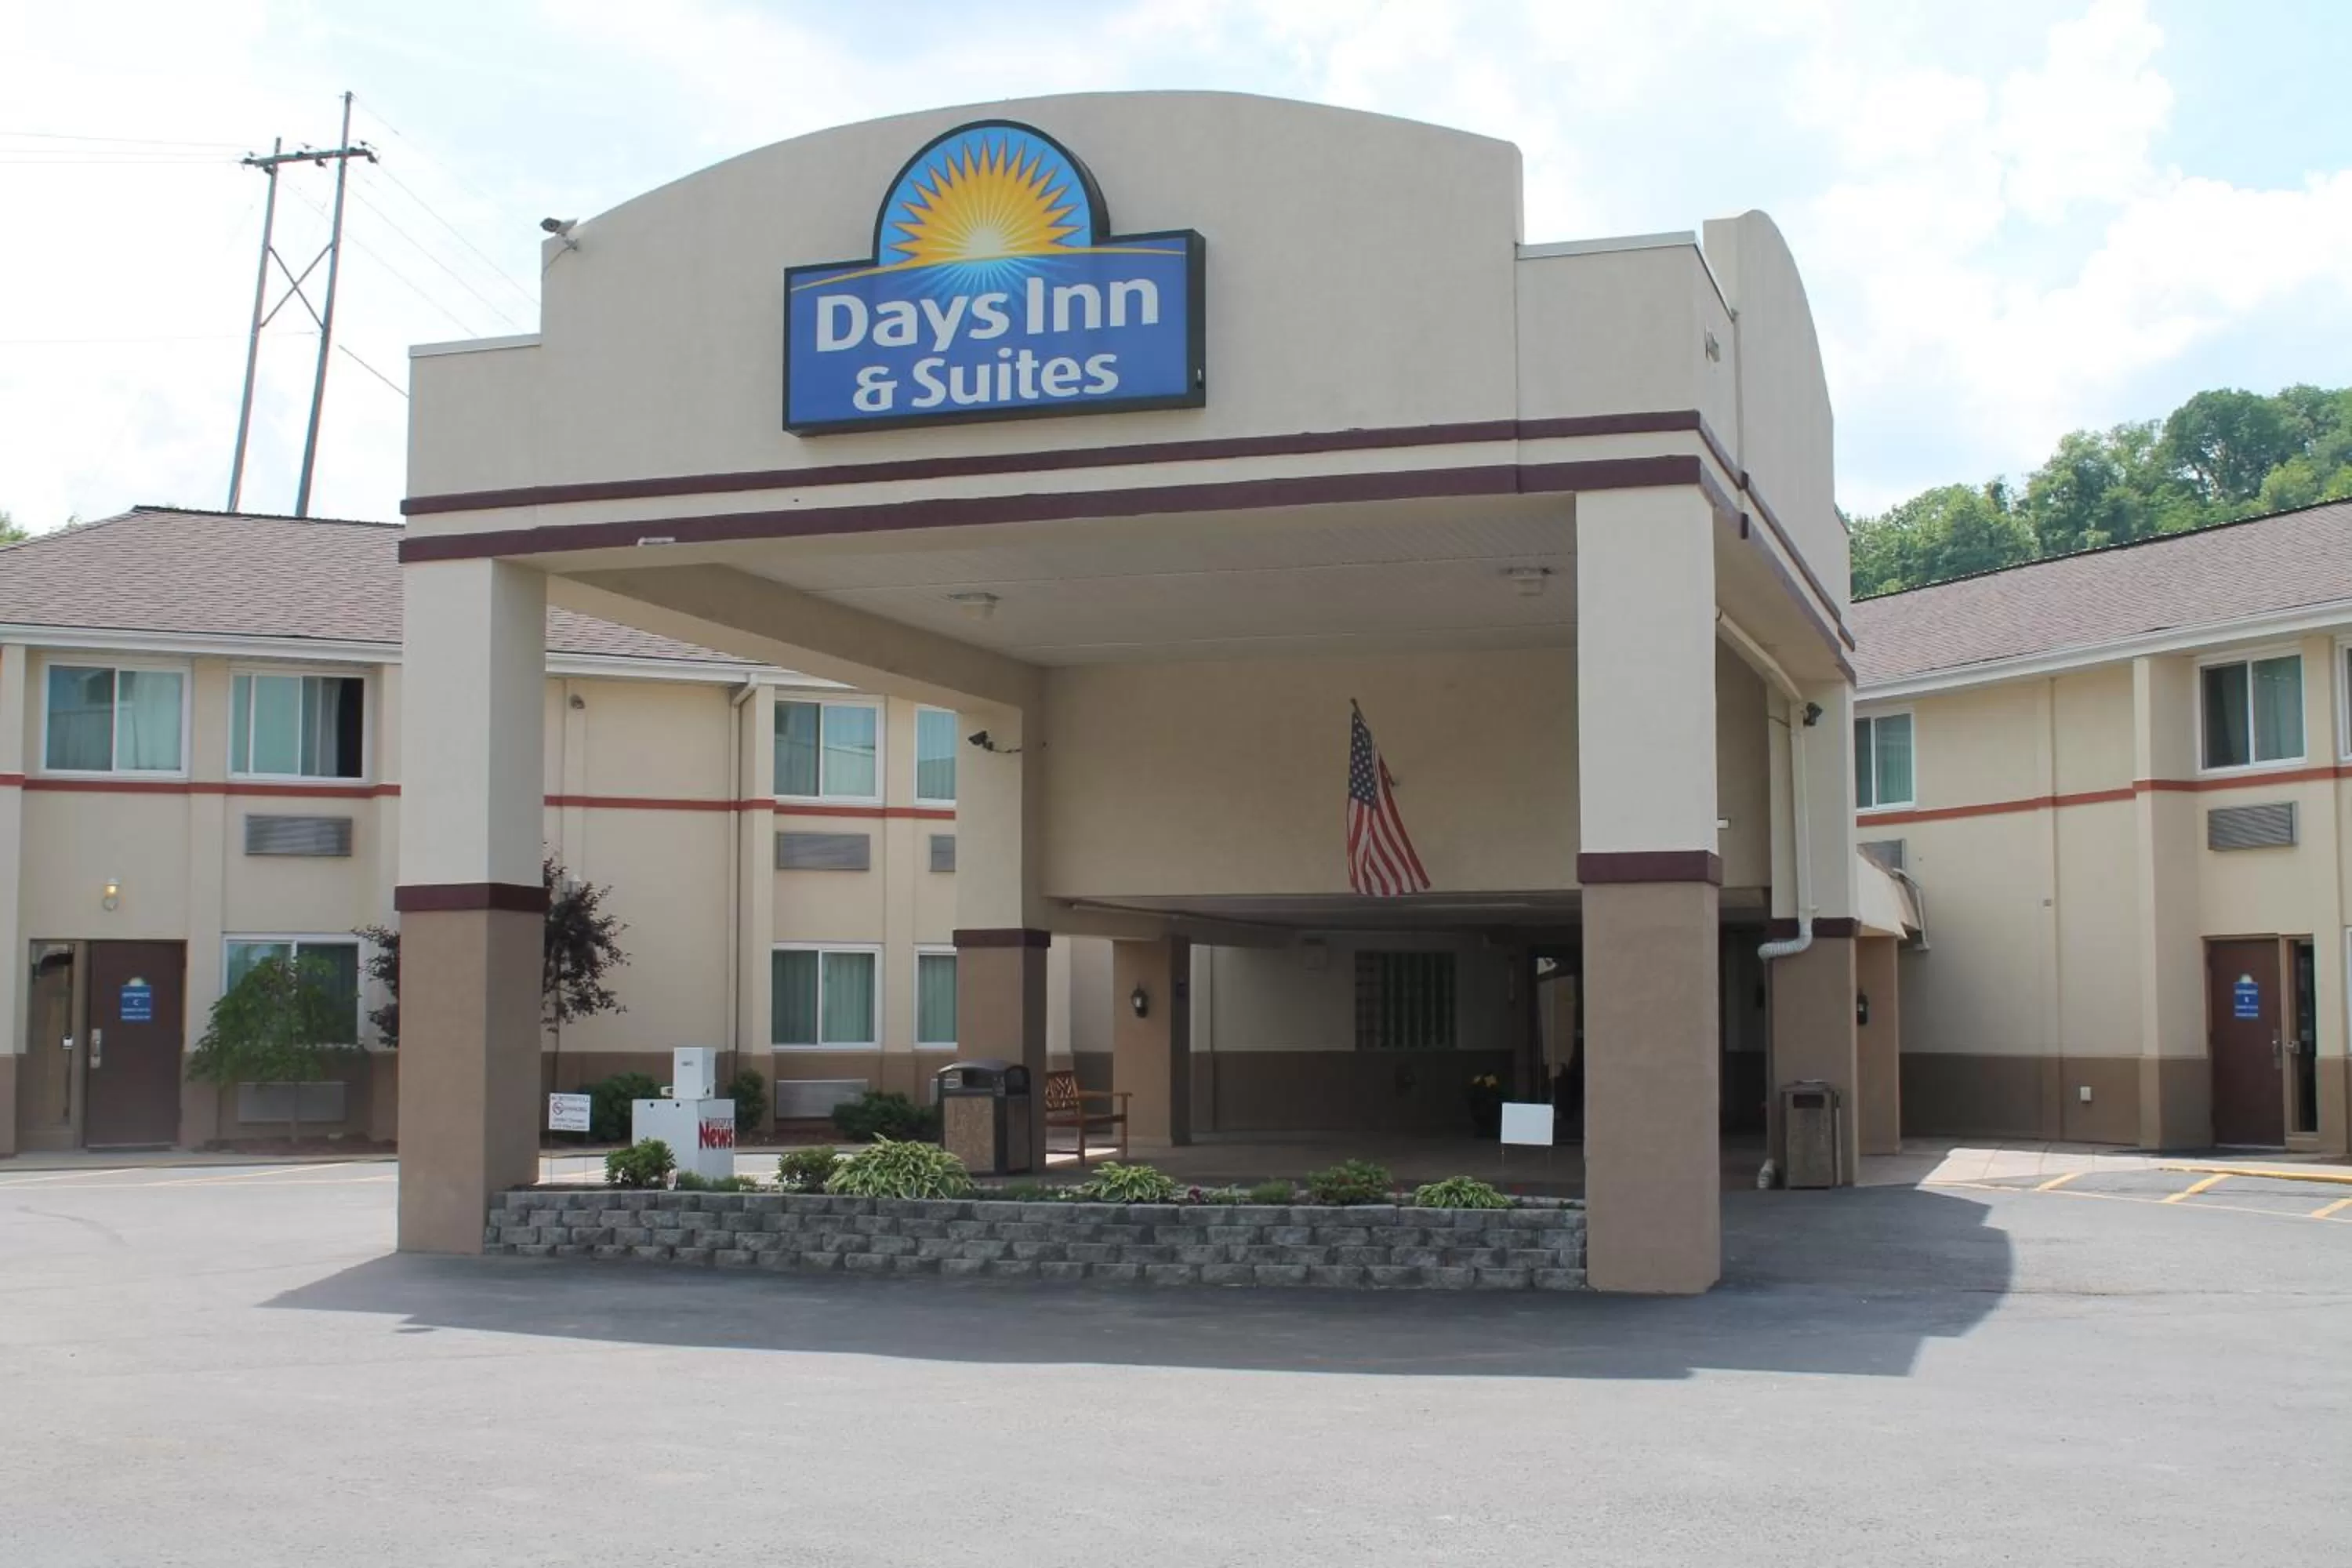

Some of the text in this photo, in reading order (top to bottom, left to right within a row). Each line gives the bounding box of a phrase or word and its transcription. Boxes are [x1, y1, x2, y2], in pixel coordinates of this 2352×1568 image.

[816, 277, 1159, 352] Days Inn
[853, 347, 1119, 412] & Suites
[699, 1120, 733, 1149] News
